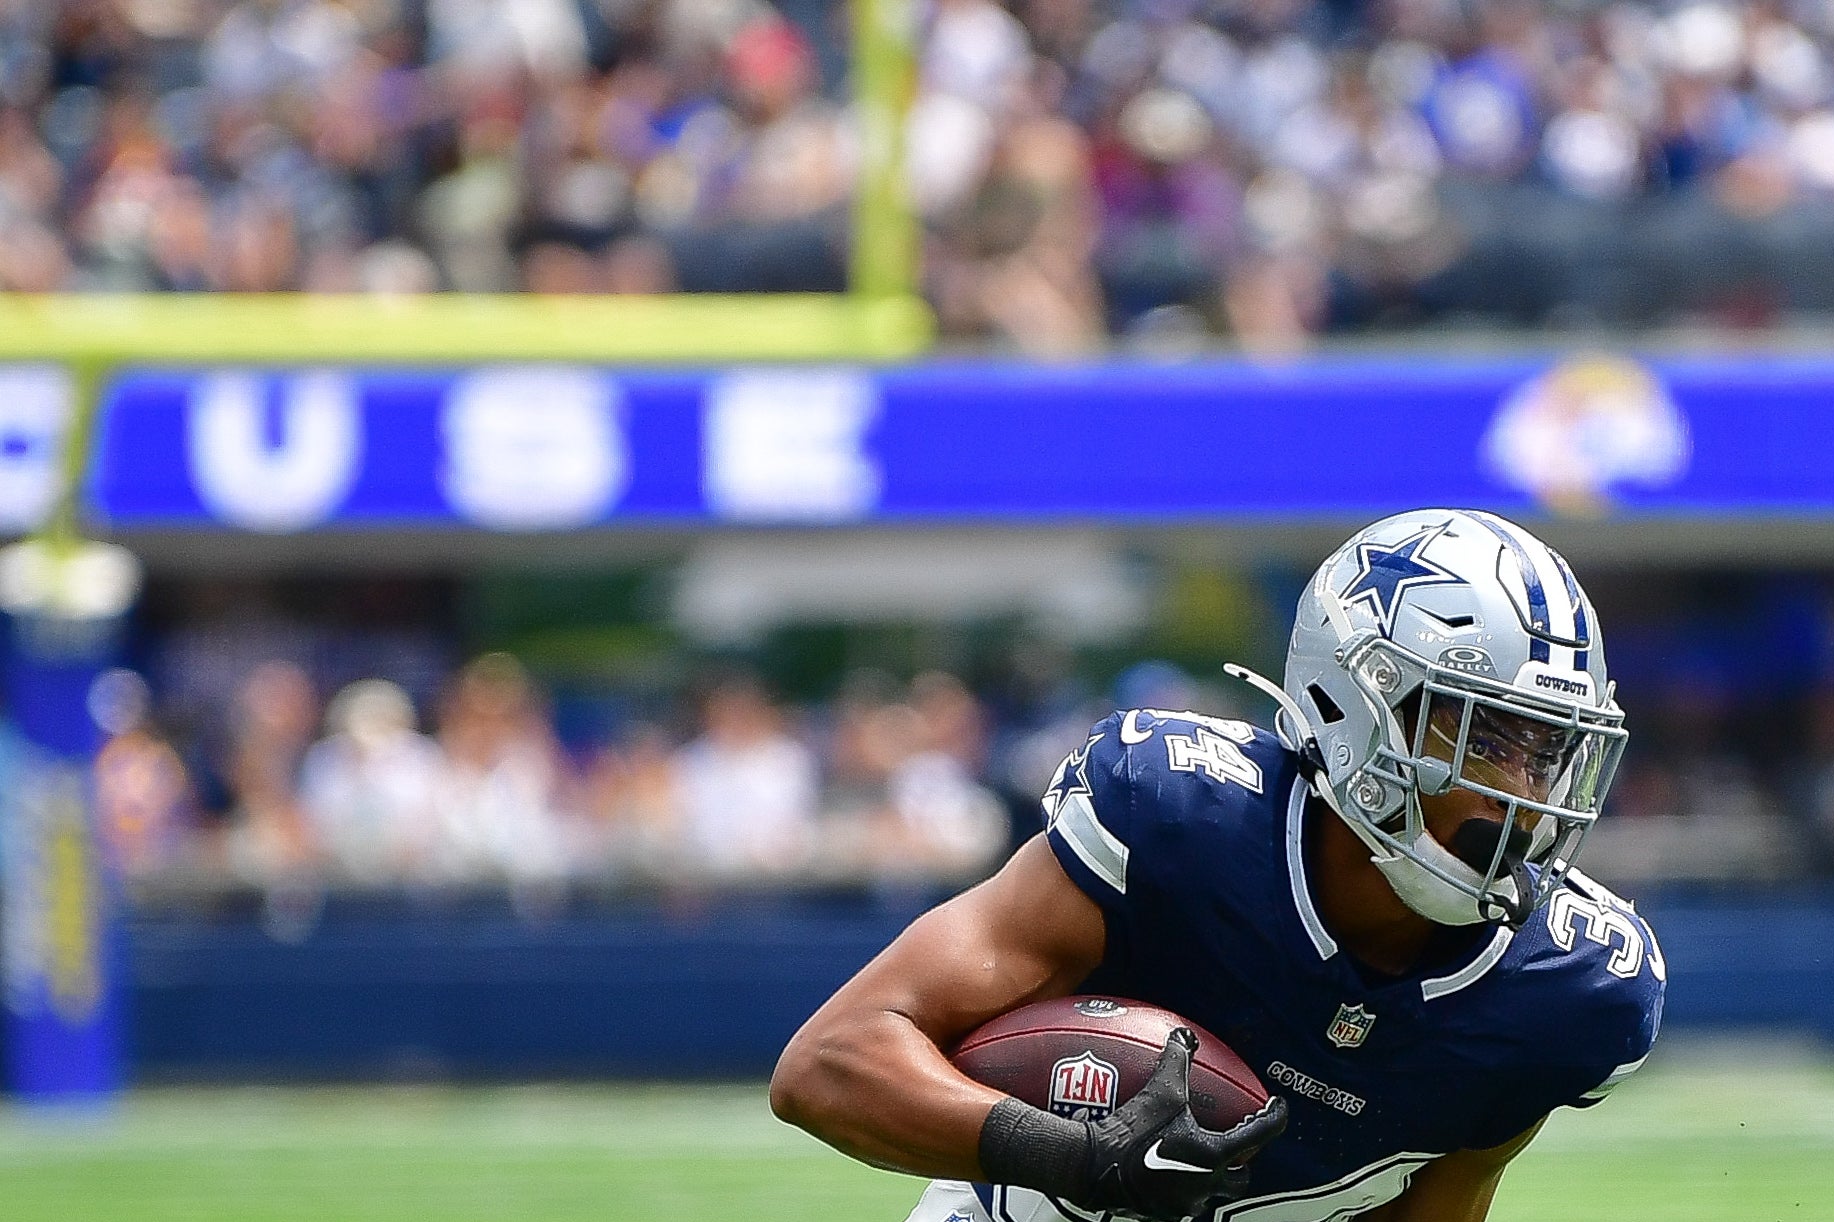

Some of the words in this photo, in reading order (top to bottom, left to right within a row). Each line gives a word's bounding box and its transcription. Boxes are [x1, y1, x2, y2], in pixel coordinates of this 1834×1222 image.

[1438, 660, 1492, 672] OAKLEY
[1535, 674, 1588, 697] COWBOYS
[1333, 1021, 1362, 1042] NFL
[1058, 1063, 1111, 1104] NFL
[1267, 1061, 1367, 1116] COWBOYS
